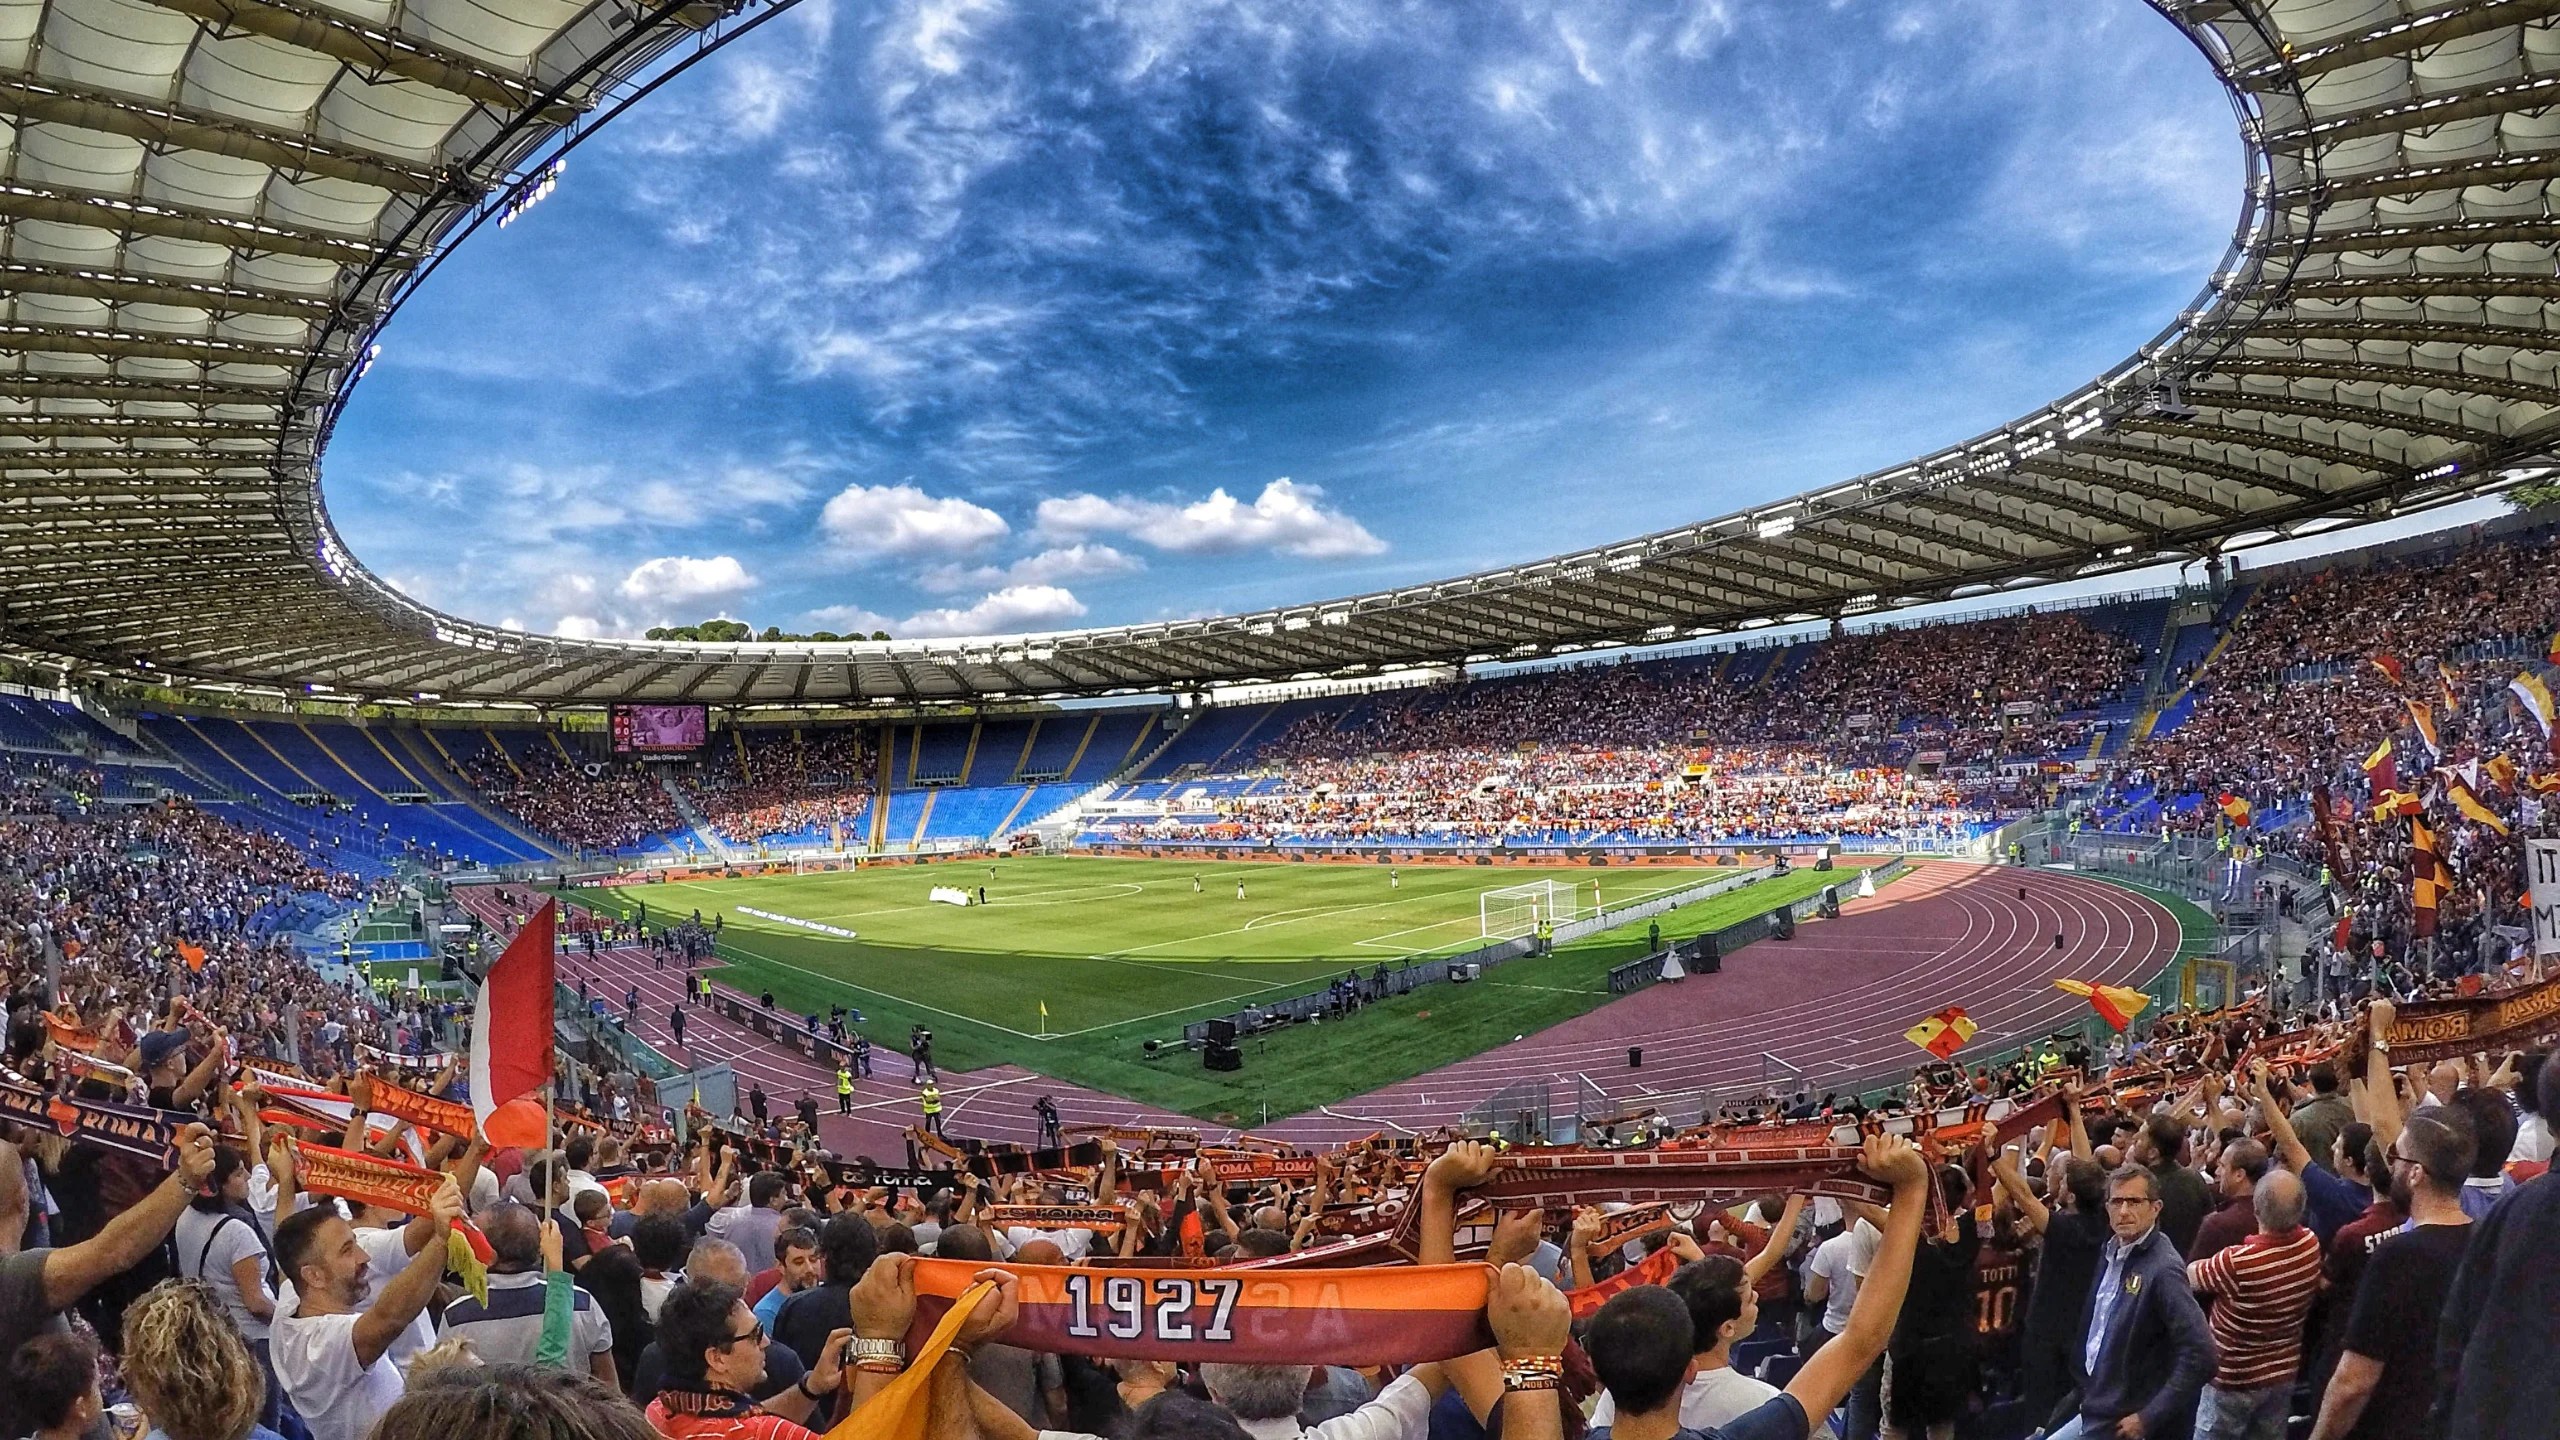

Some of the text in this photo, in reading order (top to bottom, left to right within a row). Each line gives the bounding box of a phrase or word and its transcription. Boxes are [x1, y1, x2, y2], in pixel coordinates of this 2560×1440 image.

[662, 754, 688, 763] Olimpico
[1958, 777, 1991, 786] COMO
[82, 1110, 157, 1144] ROMA
[1274, 1160, 1316, 1172] ROMA
[1036, 1206, 1114, 1221] roma
[1981, 1265, 2018, 1283] TOTTI
[1066, 1274, 1242, 1342] 1927
[1976, 1286, 2018, 1333] 10
